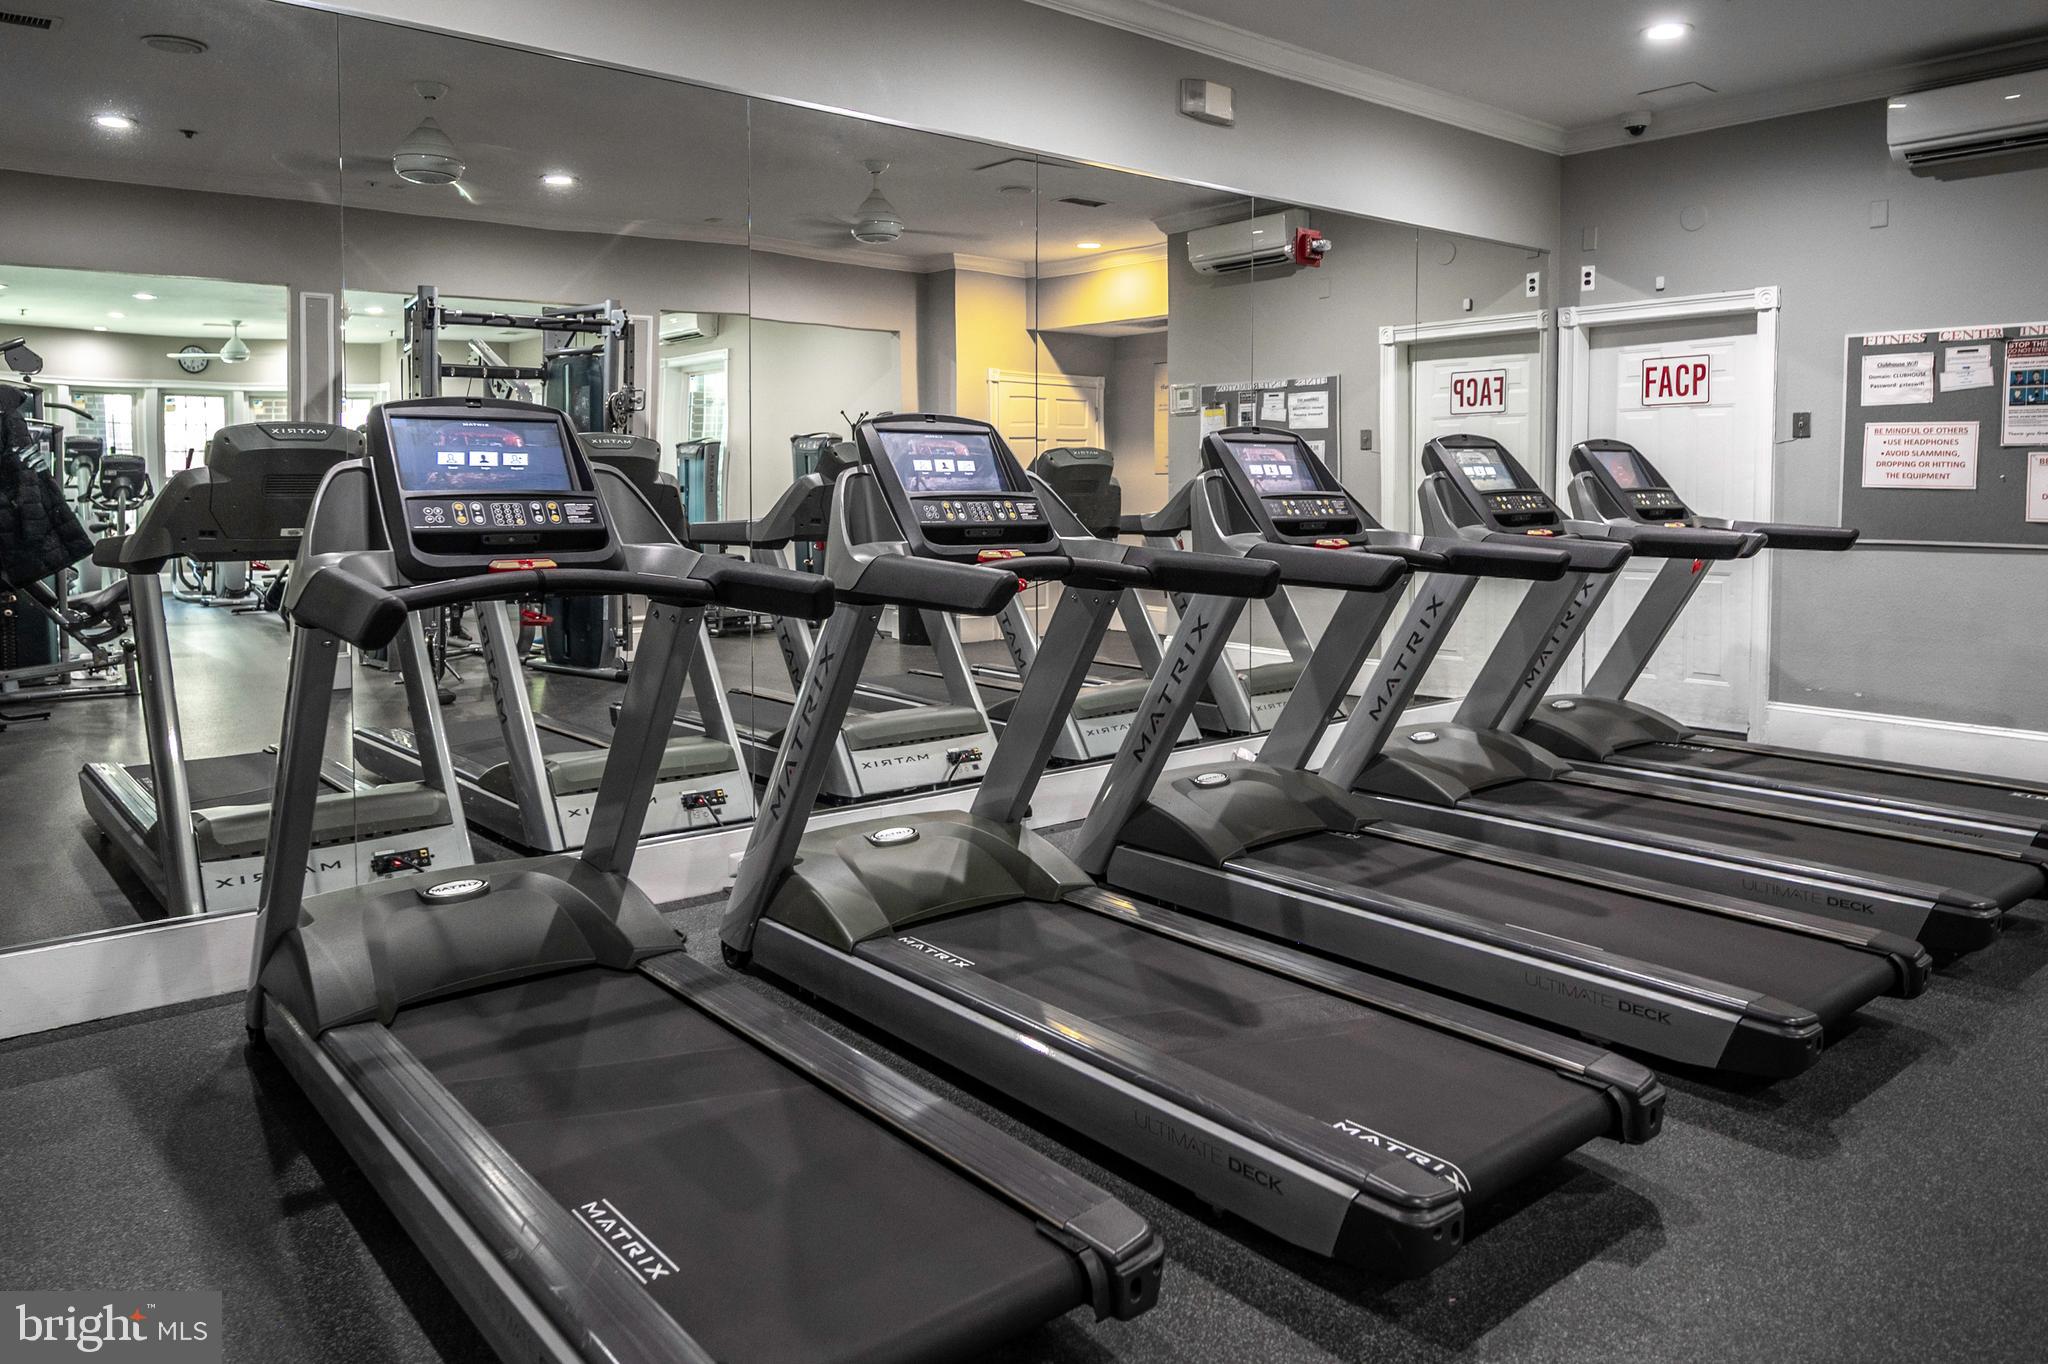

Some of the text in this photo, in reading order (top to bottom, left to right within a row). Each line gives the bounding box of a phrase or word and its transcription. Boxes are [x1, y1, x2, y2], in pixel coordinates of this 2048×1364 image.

[1865, 333, 1928, 346] FITNESS
[1940, 327, 2002, 341] CENTER
[2008, 341, 2031, 349] STOP
[1644, 362, 1708, 399] FACP
[1874, 426, 1969, 435] BE MINDFUL OF OTHERS
[1903, 438, 1960, 446] HEADPHONES
[1875, 460, 1967, 469] DROPPING OR HITTING
[1911, 450, 1961, 458] SLAMMING,
[1886, 471, 1951, 480] THE EQUIPMENT
[1523, 582, 1594, 689] MATRIX
[1368, 594, 1445, 722] MATRIX
[1132, 613, 1210, 765] MATRIX
[769, 640, 836, 822] MATRIX
[1741, 878, 1875, 915] ULTIMATE DECK
[897, 936, 972, 968] MATRIX
[1523, 971, 1673, 1025] ULTIMATE DECK
[1133, 1108, 1285, 1197] ULTIMATE DECK
[1332, 1120, 1467, 1194] MATRIX
[580, 1200, 671, 1281] MATRIX
